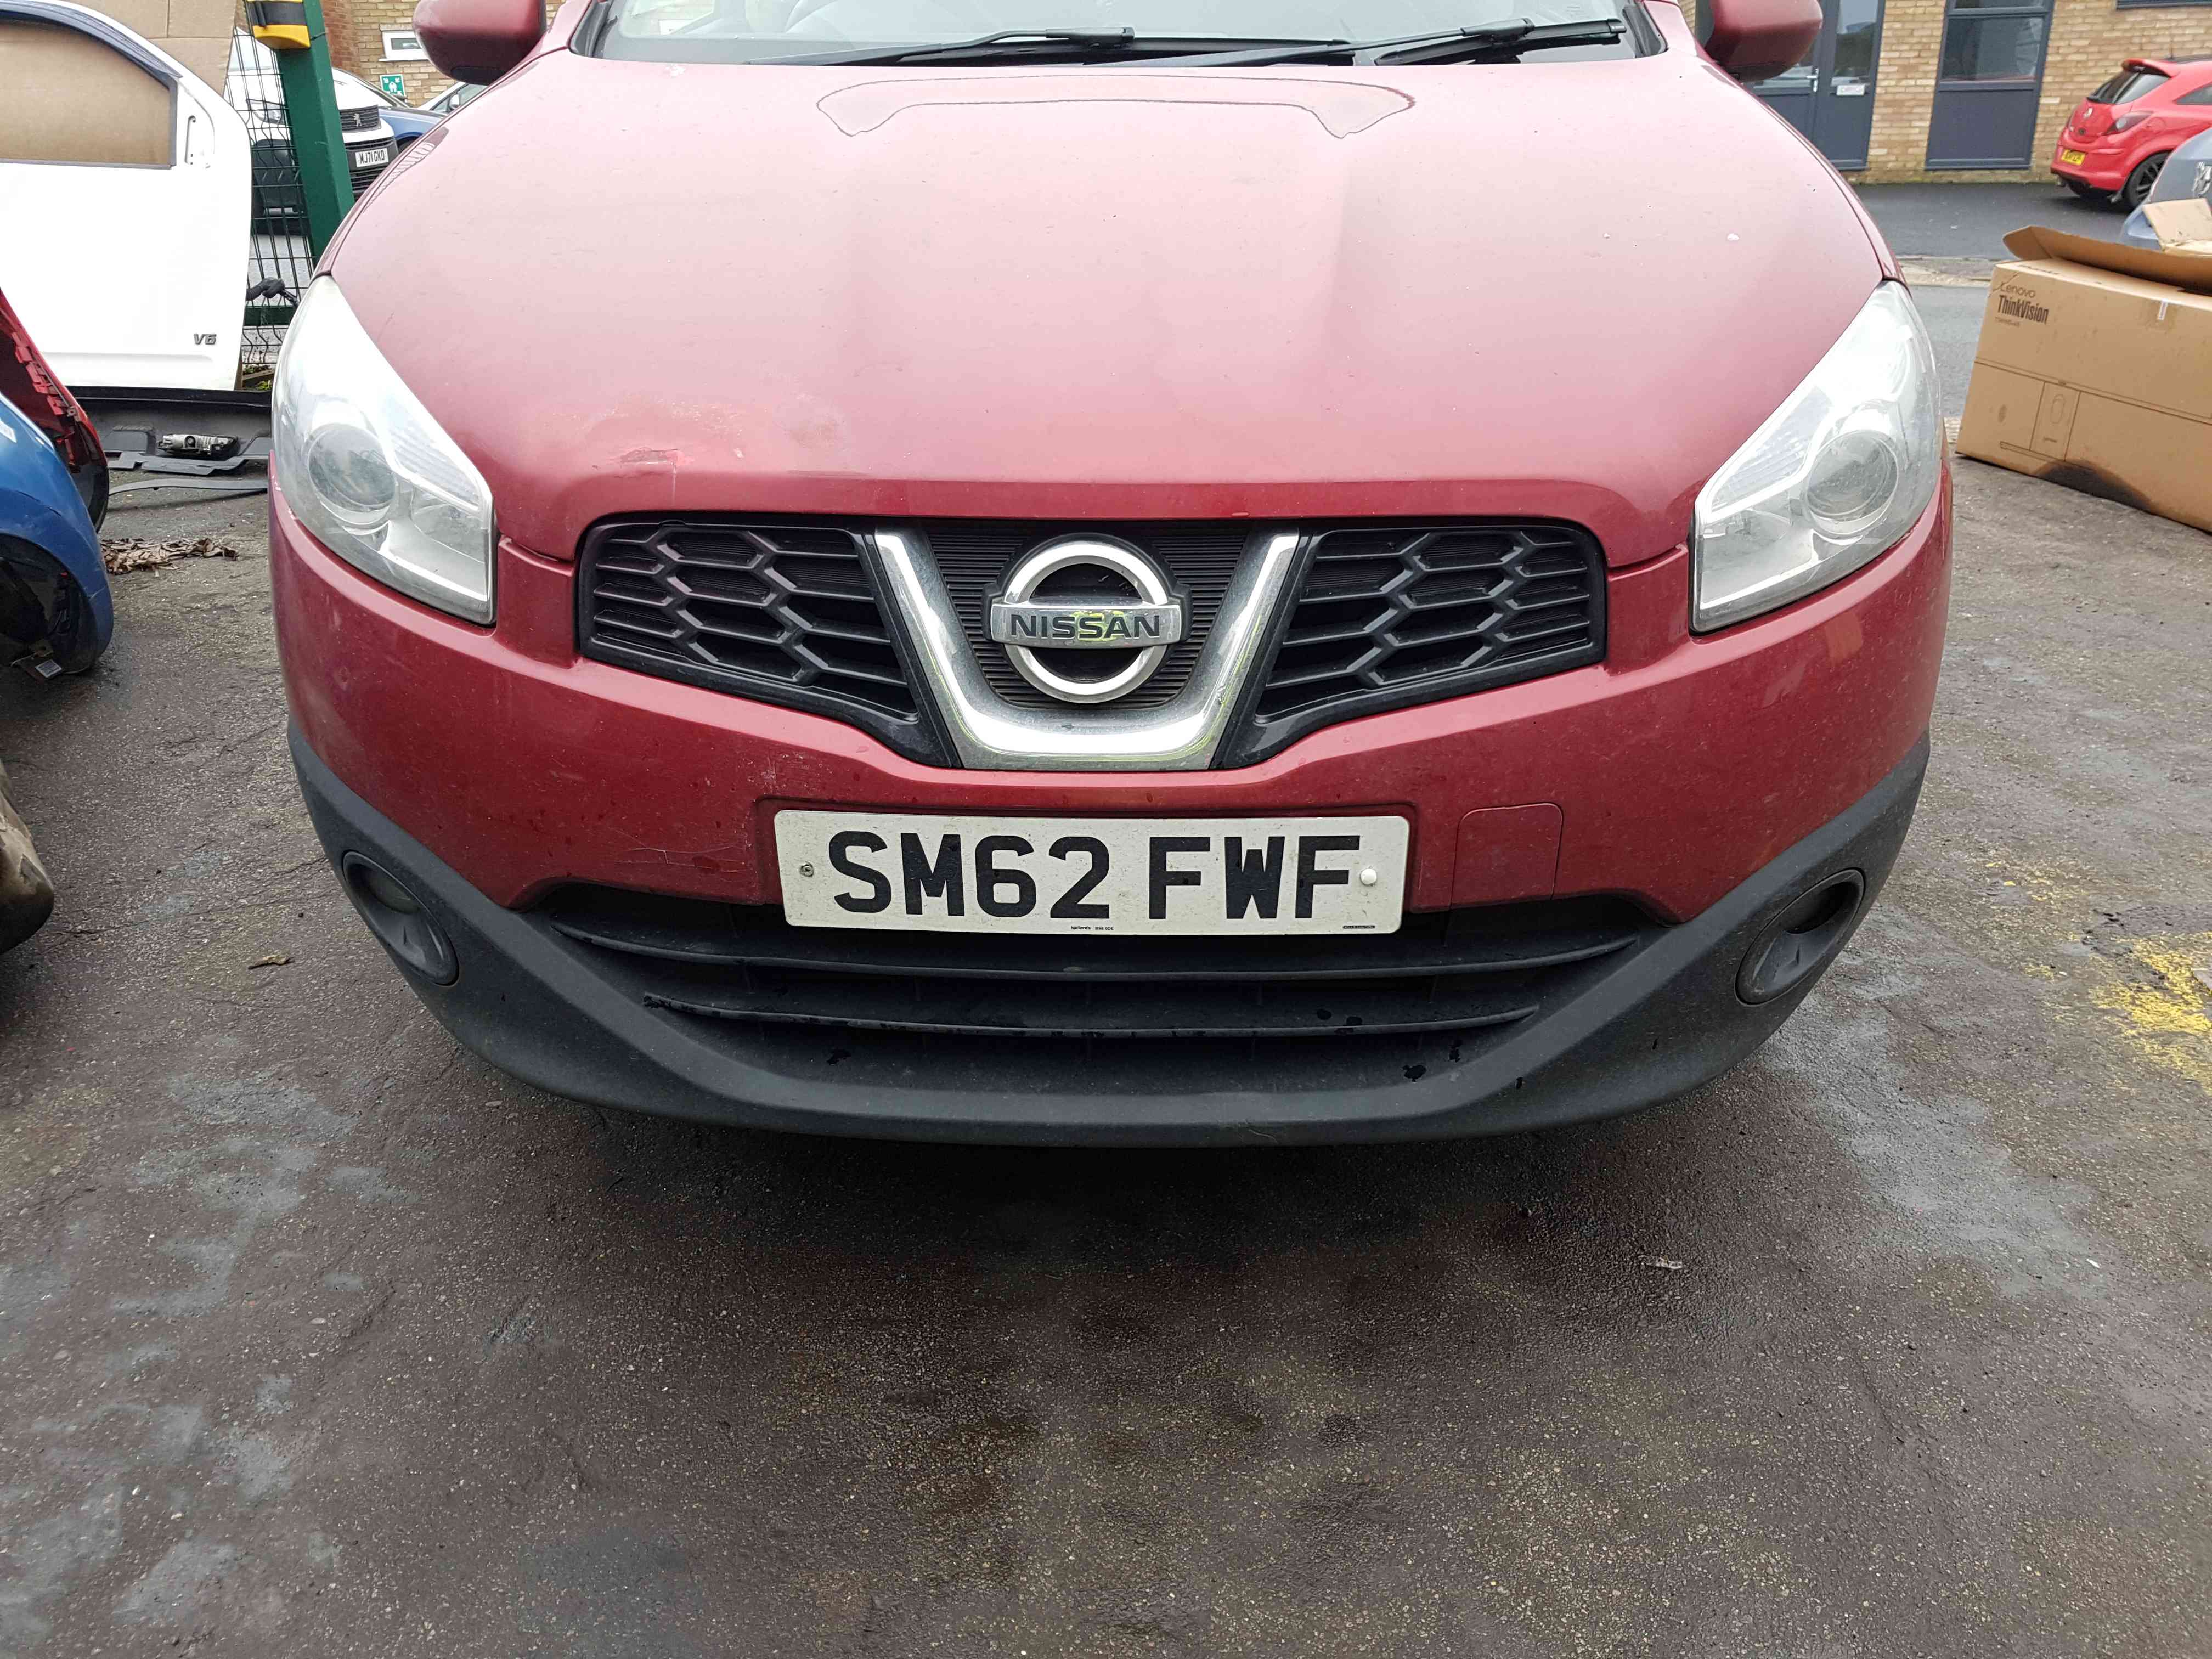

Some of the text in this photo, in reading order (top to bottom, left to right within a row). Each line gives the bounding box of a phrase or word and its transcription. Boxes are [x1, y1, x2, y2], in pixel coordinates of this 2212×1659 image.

[2000, 281, 2036, 298] Lenovo
[1997, 295, 2049, 325] ThinkVision
[194, 333, 217, 345] V6
[1011, 614, 1160, 639] NISSAN
[828, 831, 1360, 919] SM62 FWF
